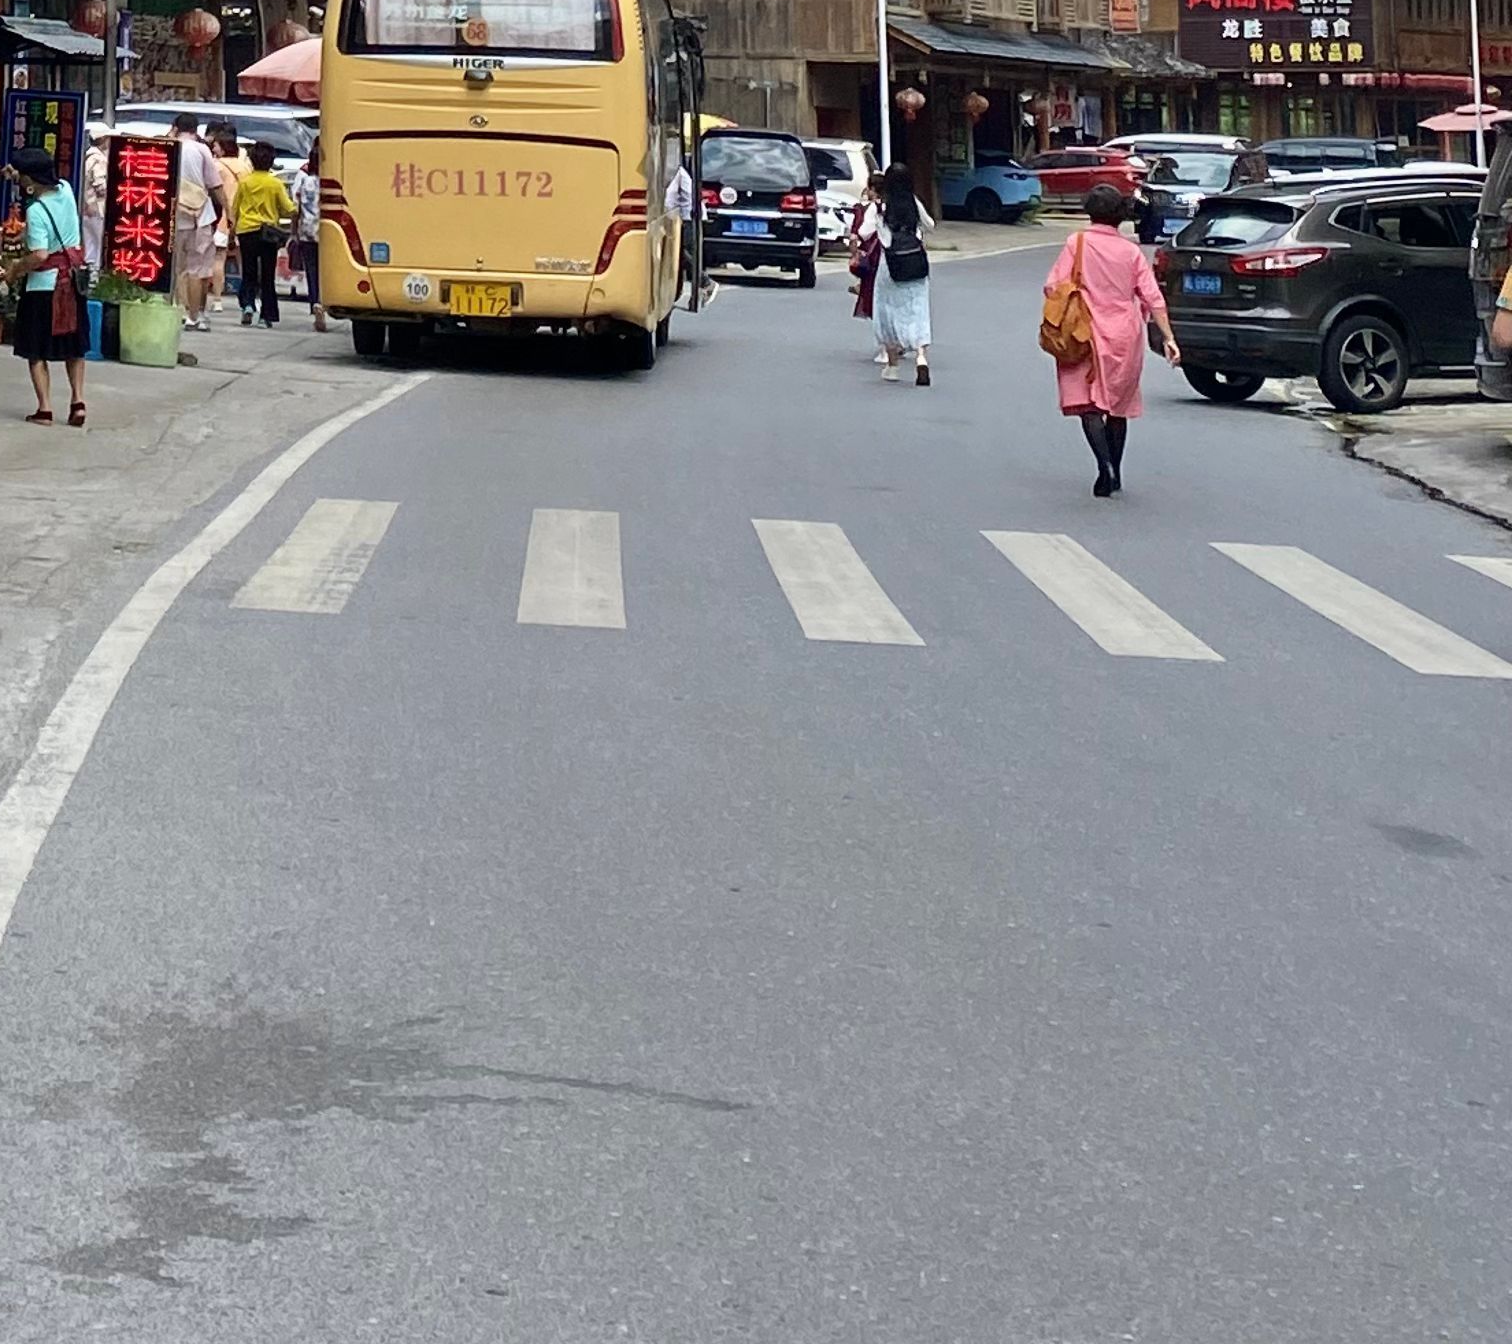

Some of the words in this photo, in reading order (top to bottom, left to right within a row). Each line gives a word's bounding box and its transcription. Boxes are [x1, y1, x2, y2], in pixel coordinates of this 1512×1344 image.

[452, 57, 505, 71] HIGER
[392, 162, 554, 199] 桂C11172
[112, 144, 170, 283] 桂林米粉
[406, 282, 429, 297] 100
[455, 295, 509, 317] 11172
